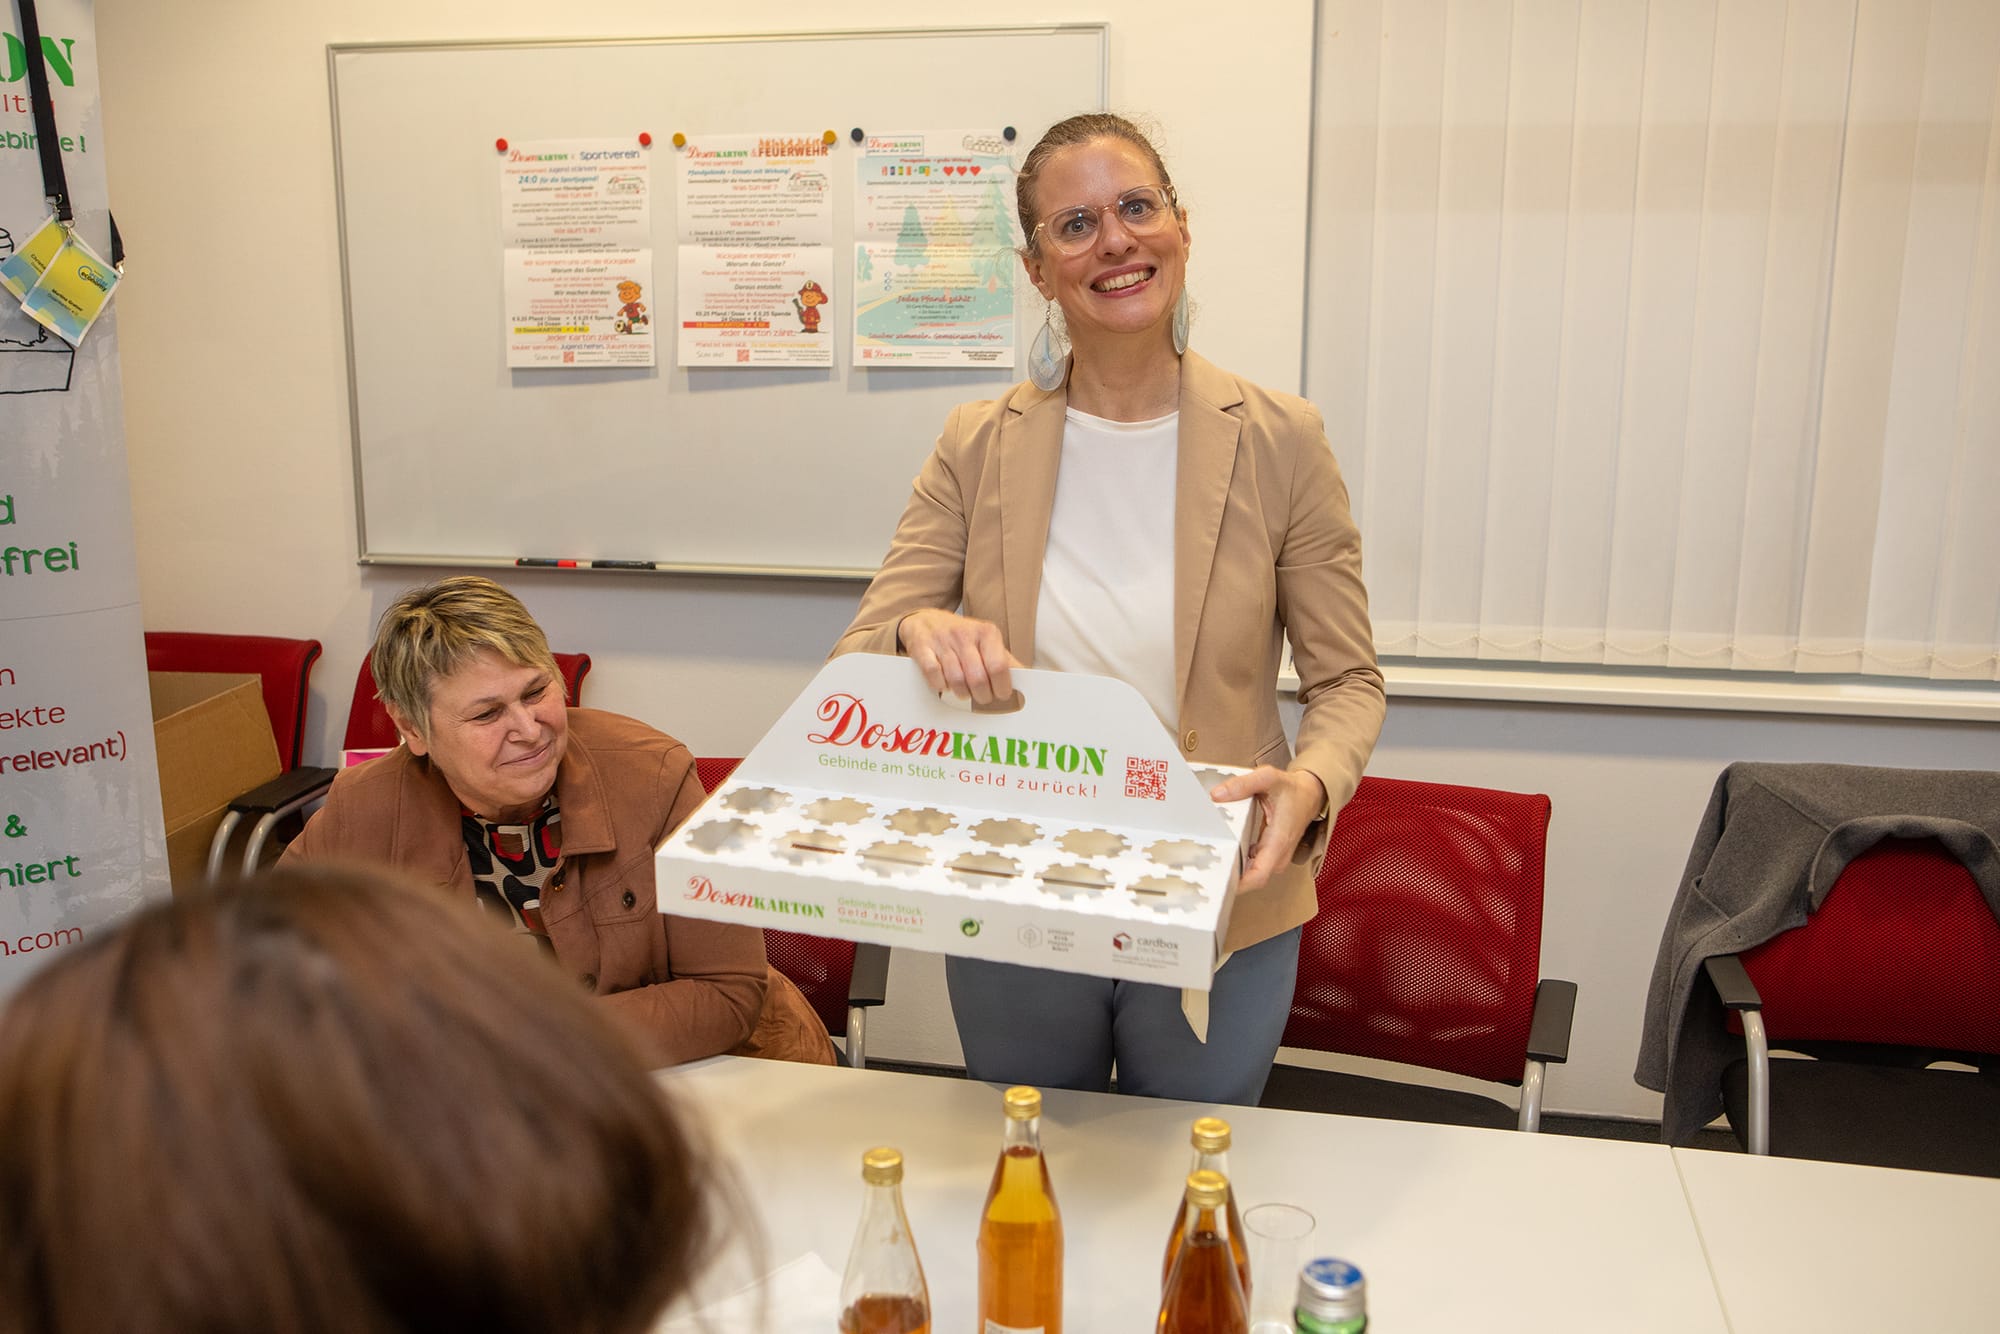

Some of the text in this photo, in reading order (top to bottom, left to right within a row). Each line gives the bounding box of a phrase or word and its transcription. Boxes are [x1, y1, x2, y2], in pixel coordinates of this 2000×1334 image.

[580, 150, 640, 161] Sportverein
[686, 146, 748, 158] DosenKARTON
[758, 144, 828, 158] FEUERWEHR
[518, 176, 538, 184] 24:0
[896, 296, 920, 304] Jedes
[546, 334, 567, 342] Jeder
[0, 706, 65, 730] ekte
[807, 692, 1109, 777] DosenKARTON
[0, 731, 127, 774] relevant)
[818, 753, 877, 772] Gebinde
[880, 762, 904, 775] am
[906, 763, 946, 781] Stück
[958, 769, 1007, 788] Geld
[1016, 778, 1098, 799] zurück!
[4, 814, 28, 838] &
[684, 875, 824, 919] DosenKARTON
[838, 907, 867, 919] Geld
[1136, 936, 1179, 950] cardbox
